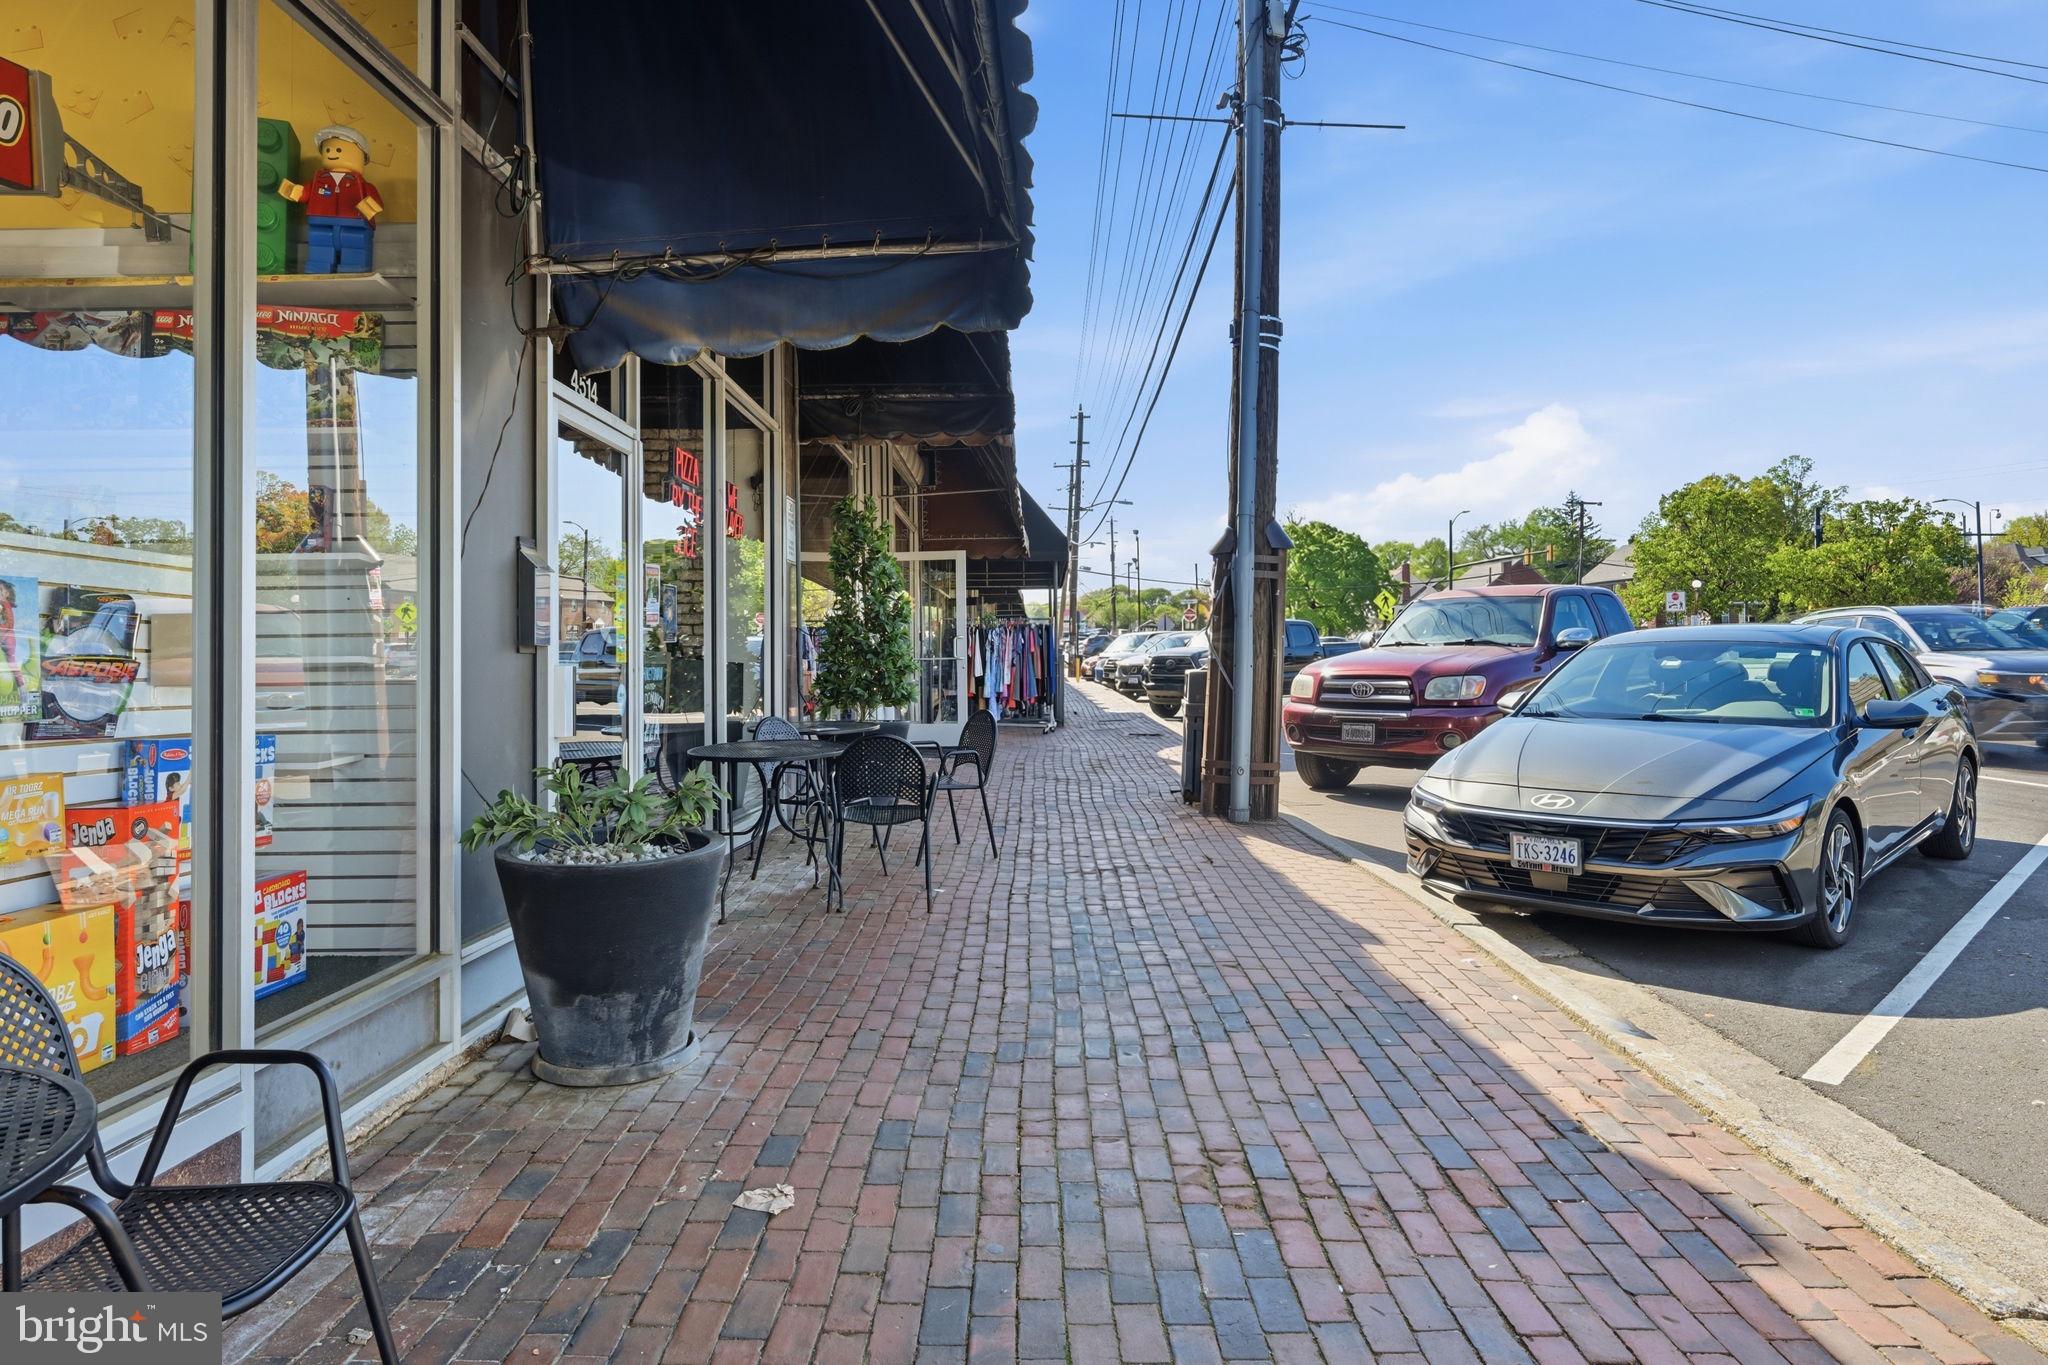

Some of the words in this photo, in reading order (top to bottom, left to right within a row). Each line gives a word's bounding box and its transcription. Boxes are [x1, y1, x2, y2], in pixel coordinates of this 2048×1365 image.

[274, 309, 341, 328] NINJAGO
[570, 368, 598, 405] 4514
[675, 446, 699, 487] PIZZA
[44, 660, 140, 677] AEROBIE
[255, 745, 275, 763] CKS
[72, 817, 116, 847] Jenga
[263, 882, 306, 909] BLOCKS
[277, 922, 289, 933] 40
[136, 929, 176, 974] Jenga
